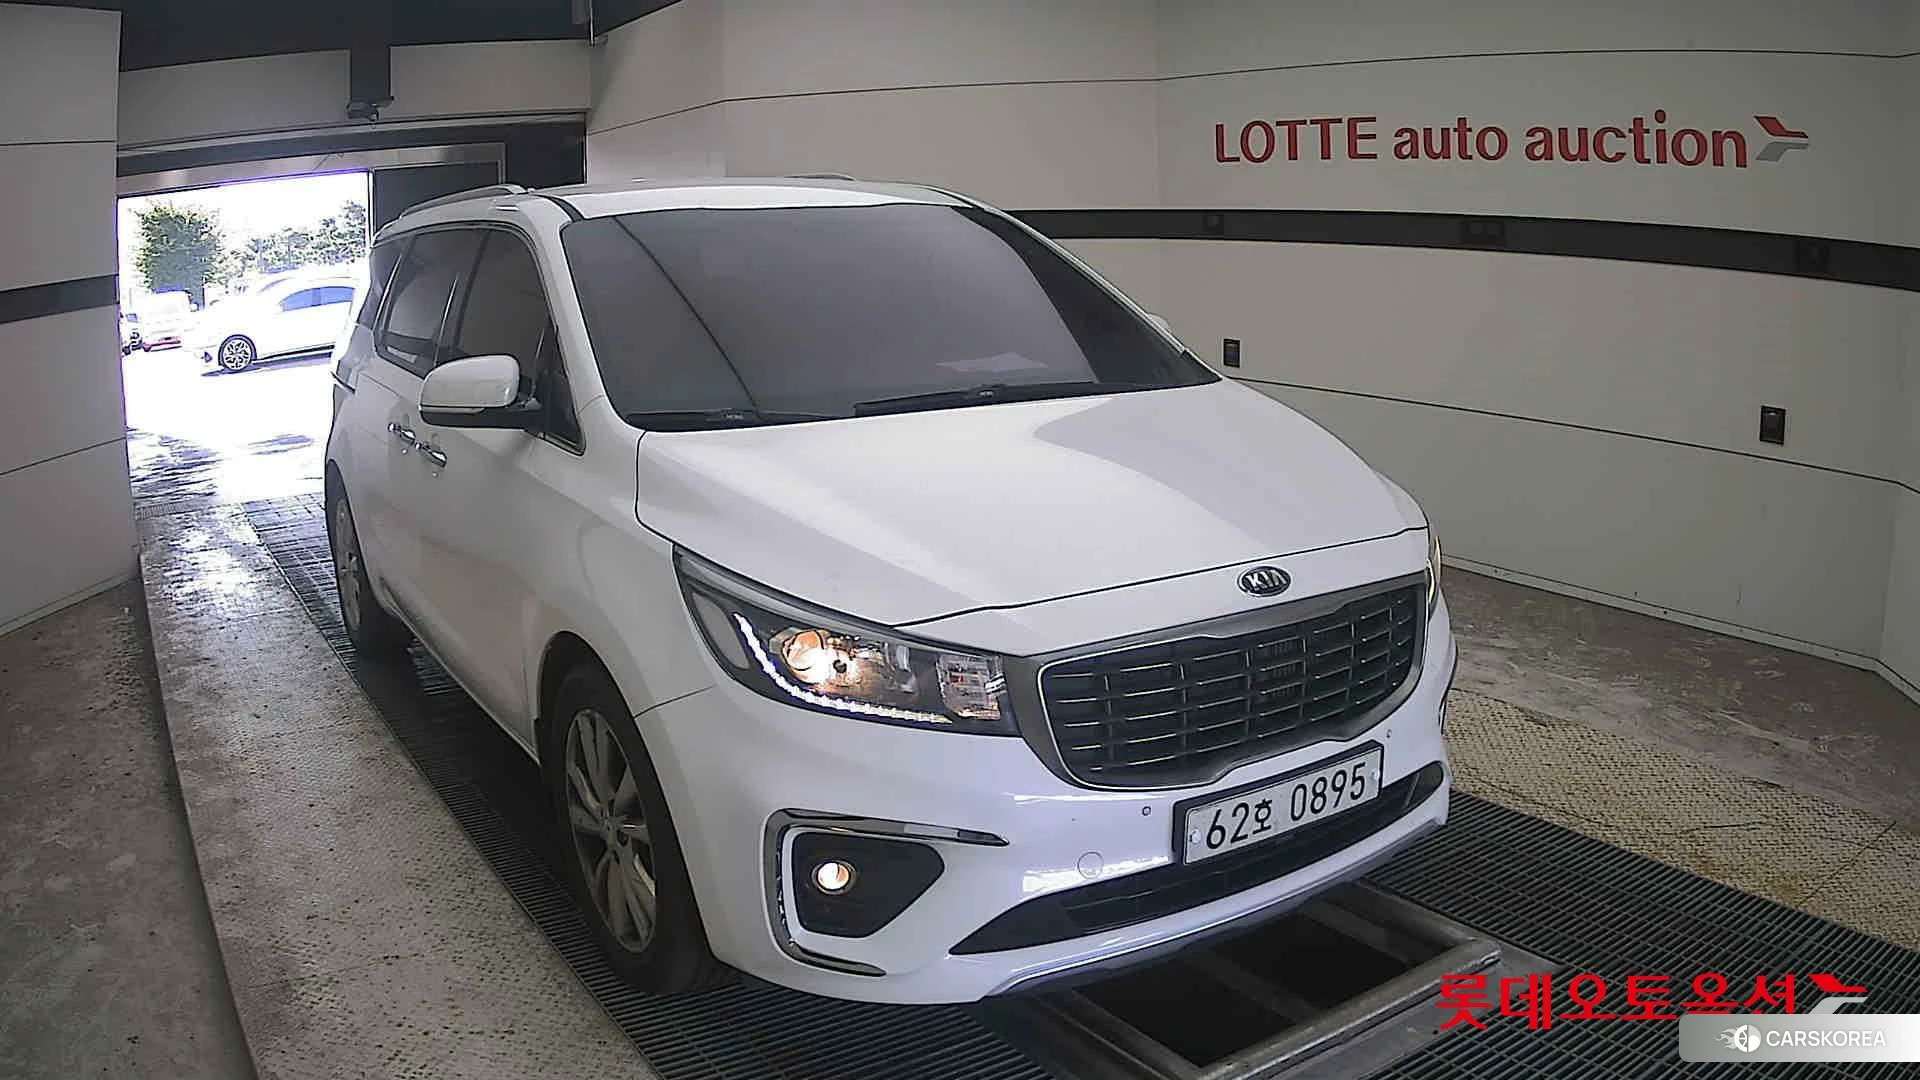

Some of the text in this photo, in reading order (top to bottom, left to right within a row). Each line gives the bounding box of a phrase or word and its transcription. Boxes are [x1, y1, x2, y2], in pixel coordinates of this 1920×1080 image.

[1215, 110, 1748, 168] LOTTE auto auction
[1244, 569, 1288, 592] KIA
[1206, 762, 1367, 849] 62호 0895
